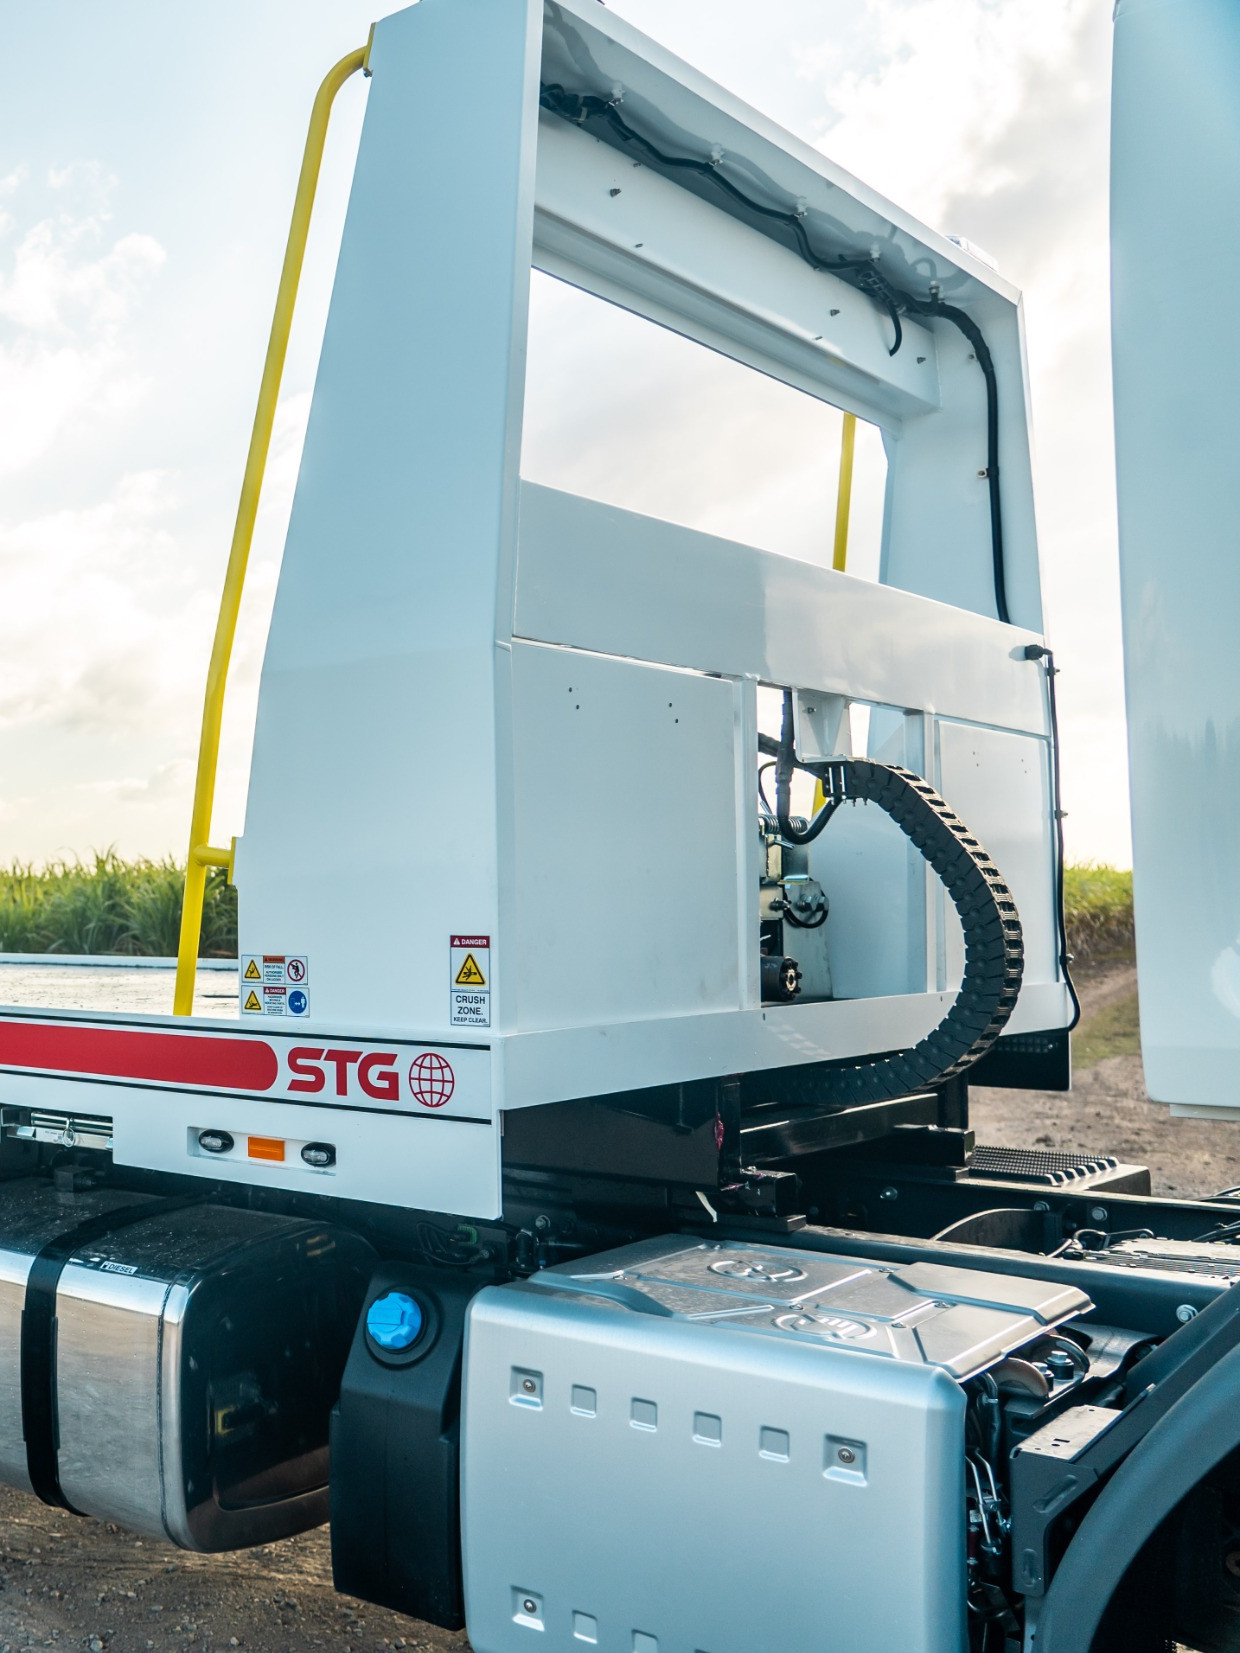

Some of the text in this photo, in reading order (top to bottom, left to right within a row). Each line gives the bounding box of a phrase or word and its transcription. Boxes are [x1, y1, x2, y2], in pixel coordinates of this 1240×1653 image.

[461, 938, 487, 946] DANGER
[455, 995, 486, 1005] CRUSH
[457, 1006, 484, 1016] ZONE.
[287, 1046, 400, 1101] STG
[108, 1263, 134, 1274] DIESEL
